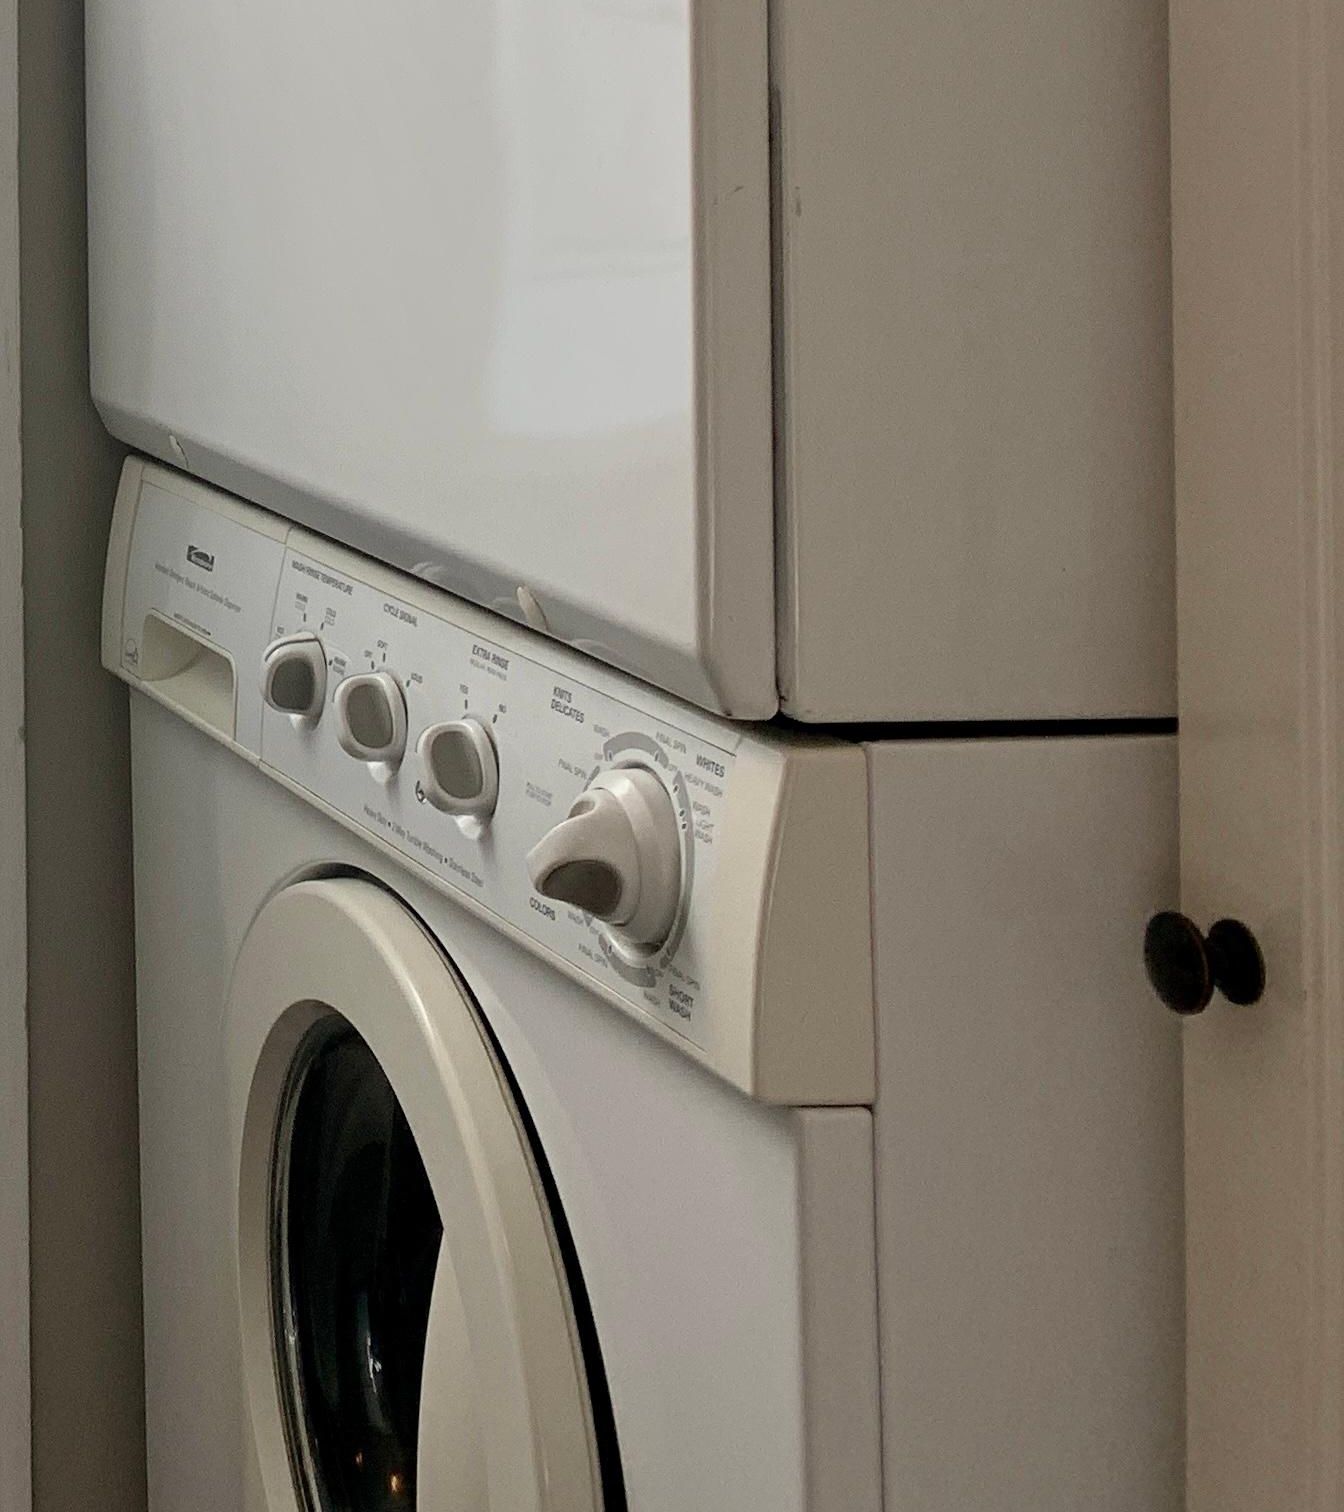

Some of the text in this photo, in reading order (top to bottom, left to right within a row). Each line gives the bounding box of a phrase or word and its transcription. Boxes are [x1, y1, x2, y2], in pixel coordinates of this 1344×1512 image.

[472, 644, 491, 662] EXTRA
[492, 653, 510, 671] RINSE
[553, 685, 572, 704] KNITS
[550, 698, 585, 724] DELICATES
[695, 753, 726, 779] WHITES
[529, 896, 556, 921] COLORS
[668, 983, 694, 1006] SHORT
[668, 997, 692, 1021] WASH
